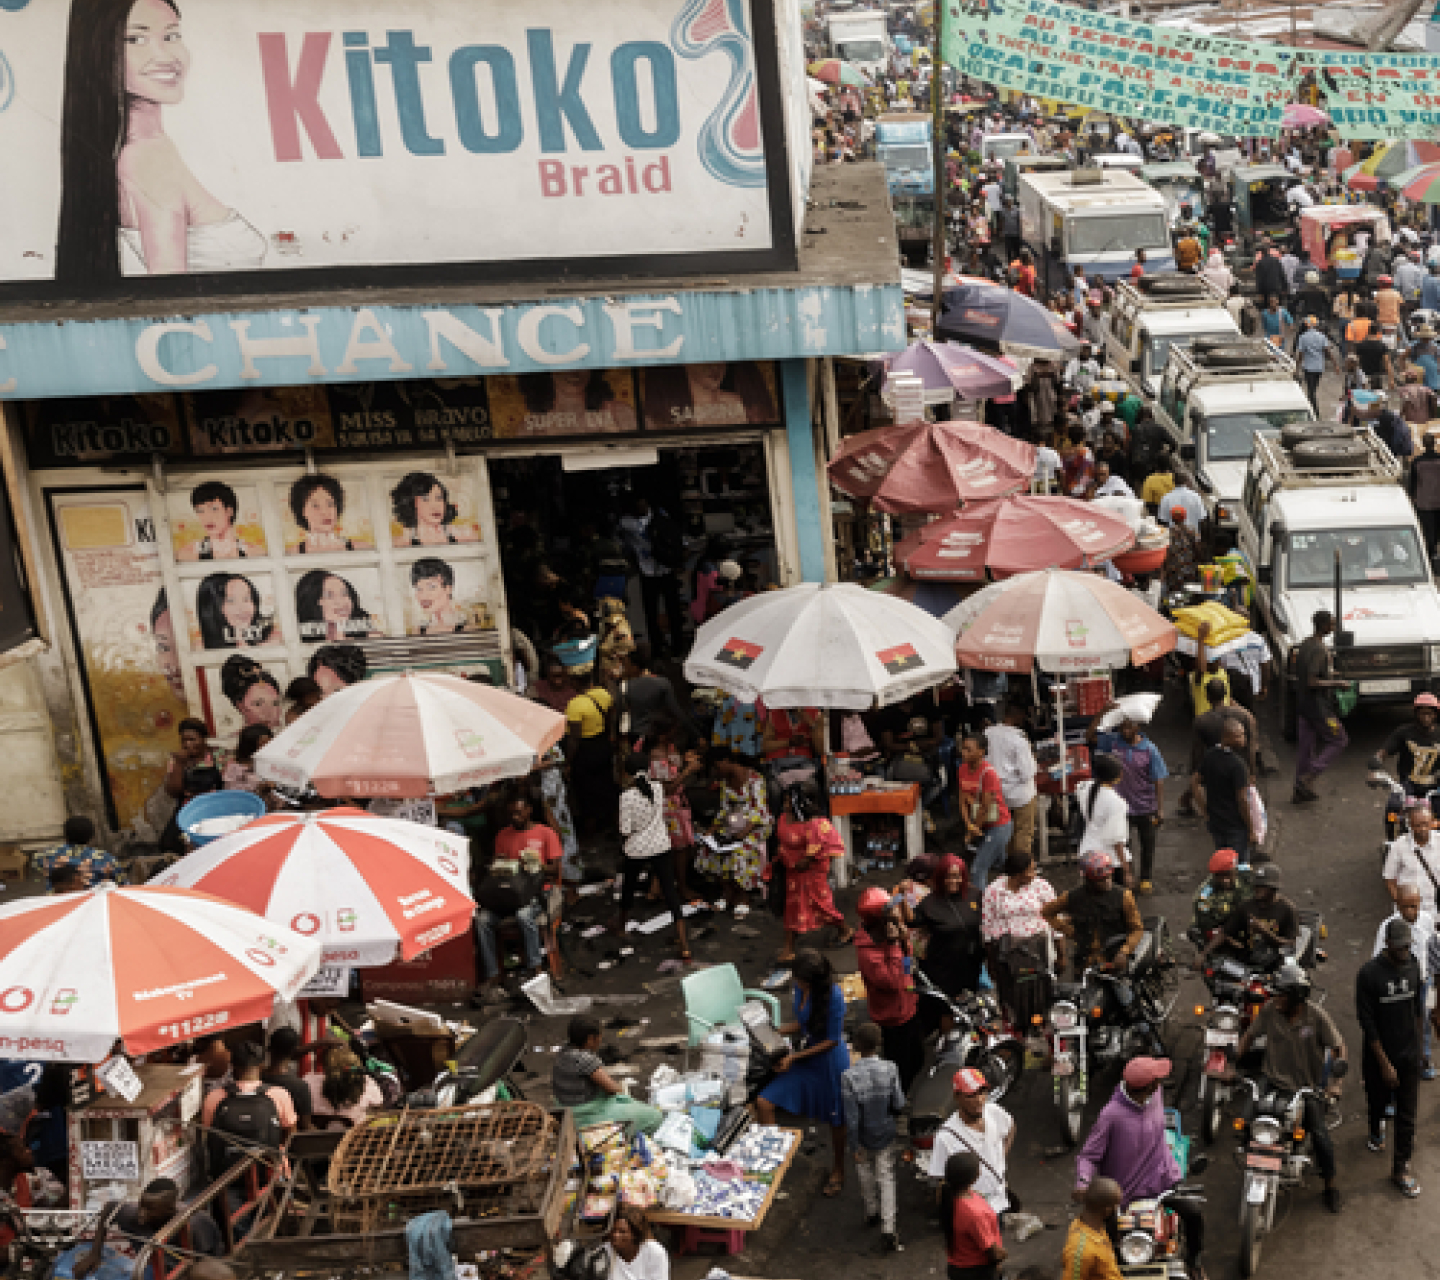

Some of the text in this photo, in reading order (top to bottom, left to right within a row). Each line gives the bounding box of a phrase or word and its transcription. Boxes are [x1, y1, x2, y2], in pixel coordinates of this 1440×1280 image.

[259, 28, 682, 162] Kitoko
[538, 156, 673, 198] Braid
[136, 297, 684, 388] CHANCE
[53, 422, 172, 456] Kitoko
[206, 414, 315, 450] Kitoko
[524, 412, 577, 433] SUPER
